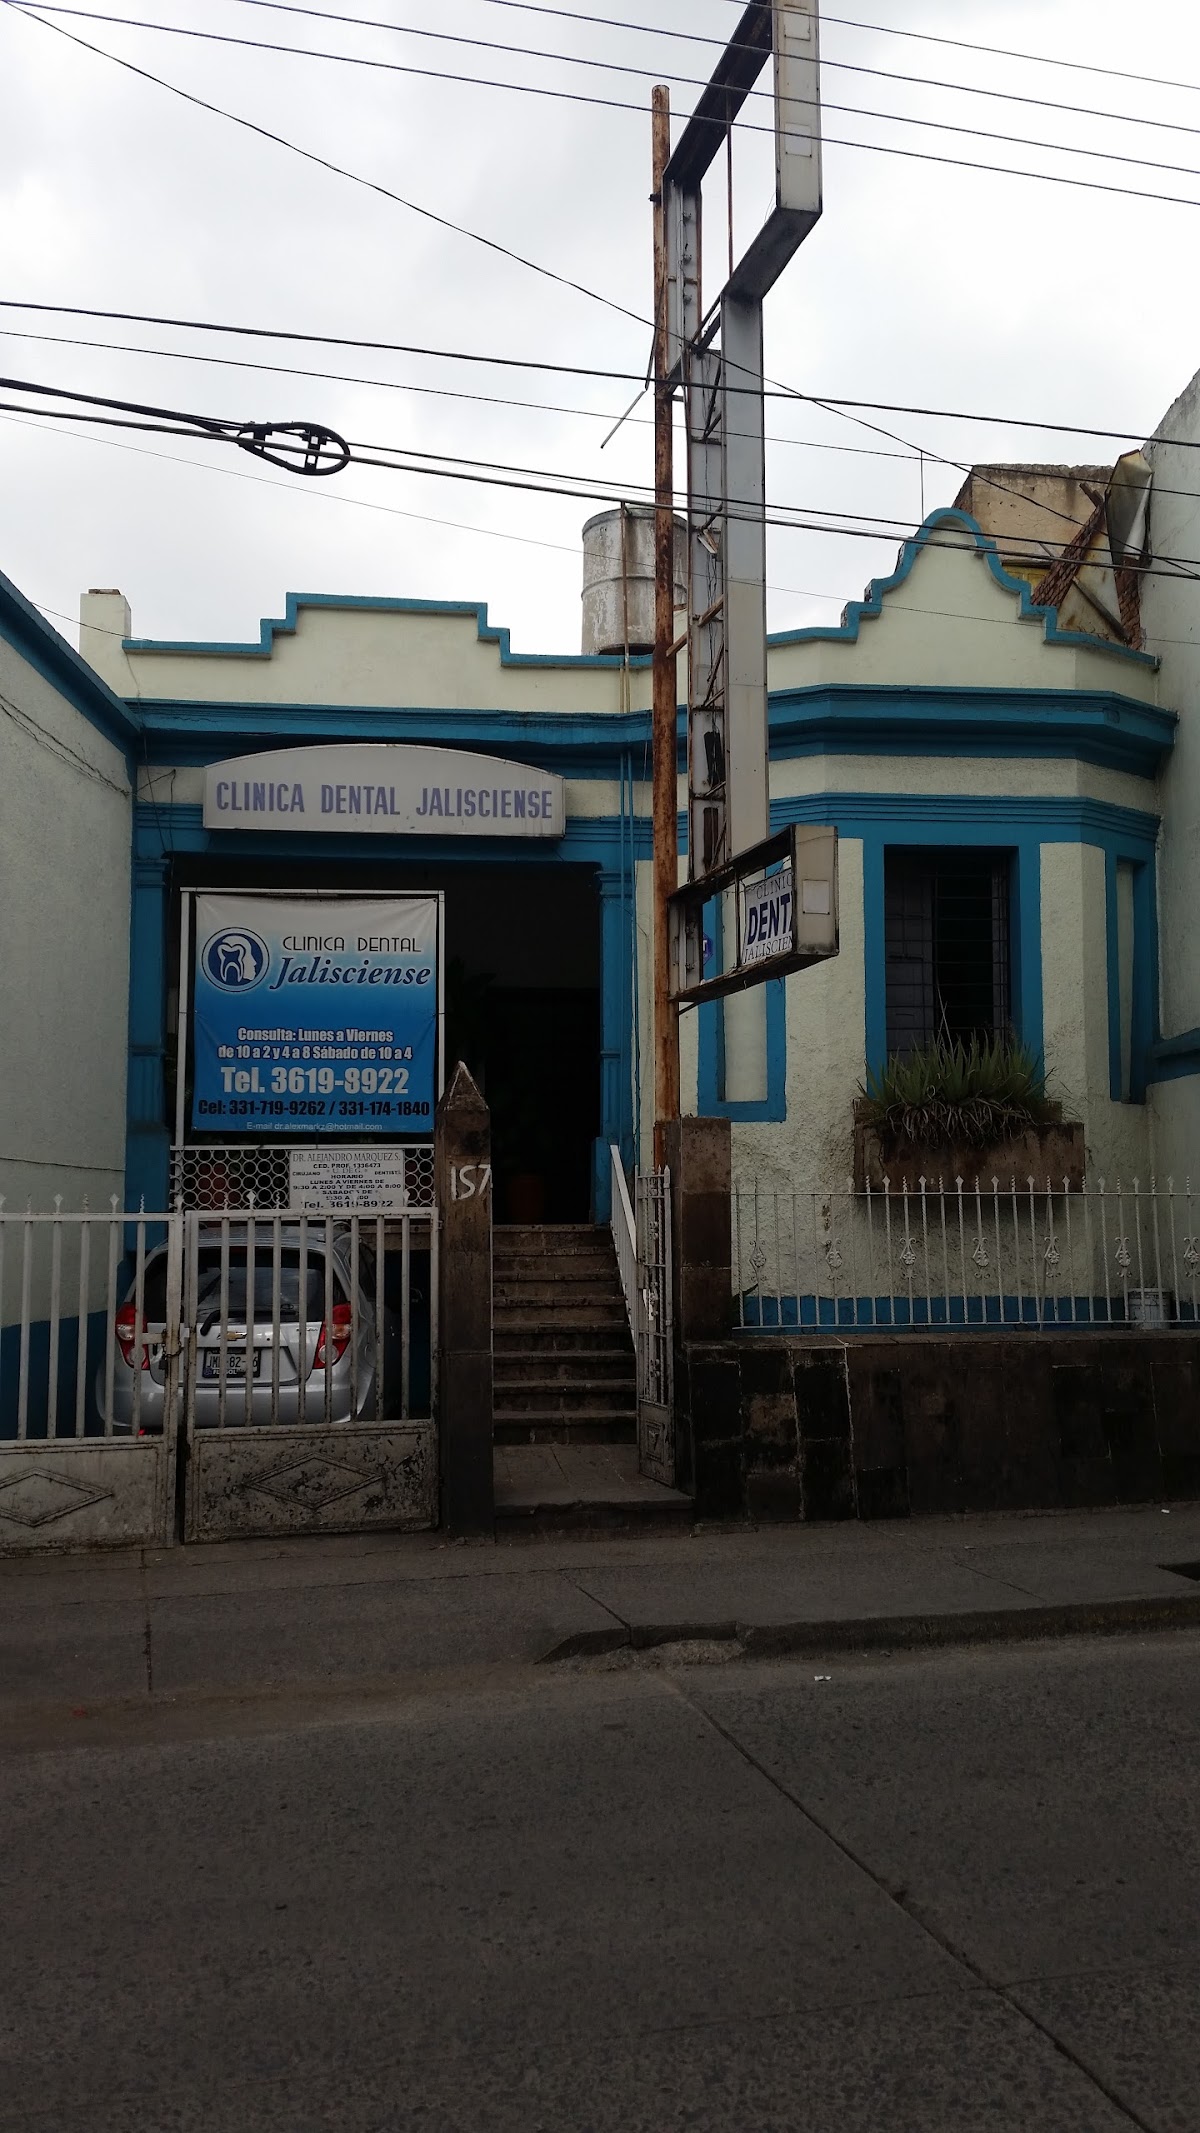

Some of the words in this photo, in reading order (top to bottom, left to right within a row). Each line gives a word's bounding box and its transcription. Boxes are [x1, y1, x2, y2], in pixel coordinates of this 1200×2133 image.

[216, 781, 305, 813] CLINICA
[320, 784, 401, 815] DENTAL
[415, 787, 552, 819] JALISCIENSE
[747, 890, 793, 945] DENT
[282, 936, 345, 952] CLINICA
[357, 937, 421, 952] DENTAL
[269, 956, 431, 990] Jalisciense
[237, 1027, 297, 1042] Consulta:
[298, 1028, 335, 1042] Lunes
[336, 1031, 345, 1042] a
[346, 1028, 394, 1043] Viernes
[217, 1045, 236, 1059] de
[237, 1045, 250, 1059] 10
[252, 1048, 261, 1059] a
[262, 1046, 271, 1059] 2
[272, 1048, 281, 1061] y
[281, 1046, 291, 1059] 4
[292, 1048, 301, 1059] a
[302, 1046, 311, 1059] 8
[312, 1045, 359, 1060] Sábado
[360, 1046, 377, 1060] de
[378, 1046, 392, 1060] 10
[393, 1049, 403, 1060] a
[403, 1046, 413, 1060] 4
[220, 1066, 266, 1094] Tel.
[271, 1066, 410, 1095] 3619-8922
[198, 1099, 226, 1115] Cel:
[229, 1100, 326, 1116] 331-719-9262
[328, 1100, 336, 1116] /
[338, 1101, 430, 1117] 331-174-1840
[246, 1121, 273, 1130] E-mail
[292, 1153, 306, 1162] DR.
[307, 1152, 353, 1162] ALEJANDRO
[353, 1152, 393, 1162] MARQUEZ
[394, 1152, 401, 1161] S.
[450, 1164, 491, 1201] 157
